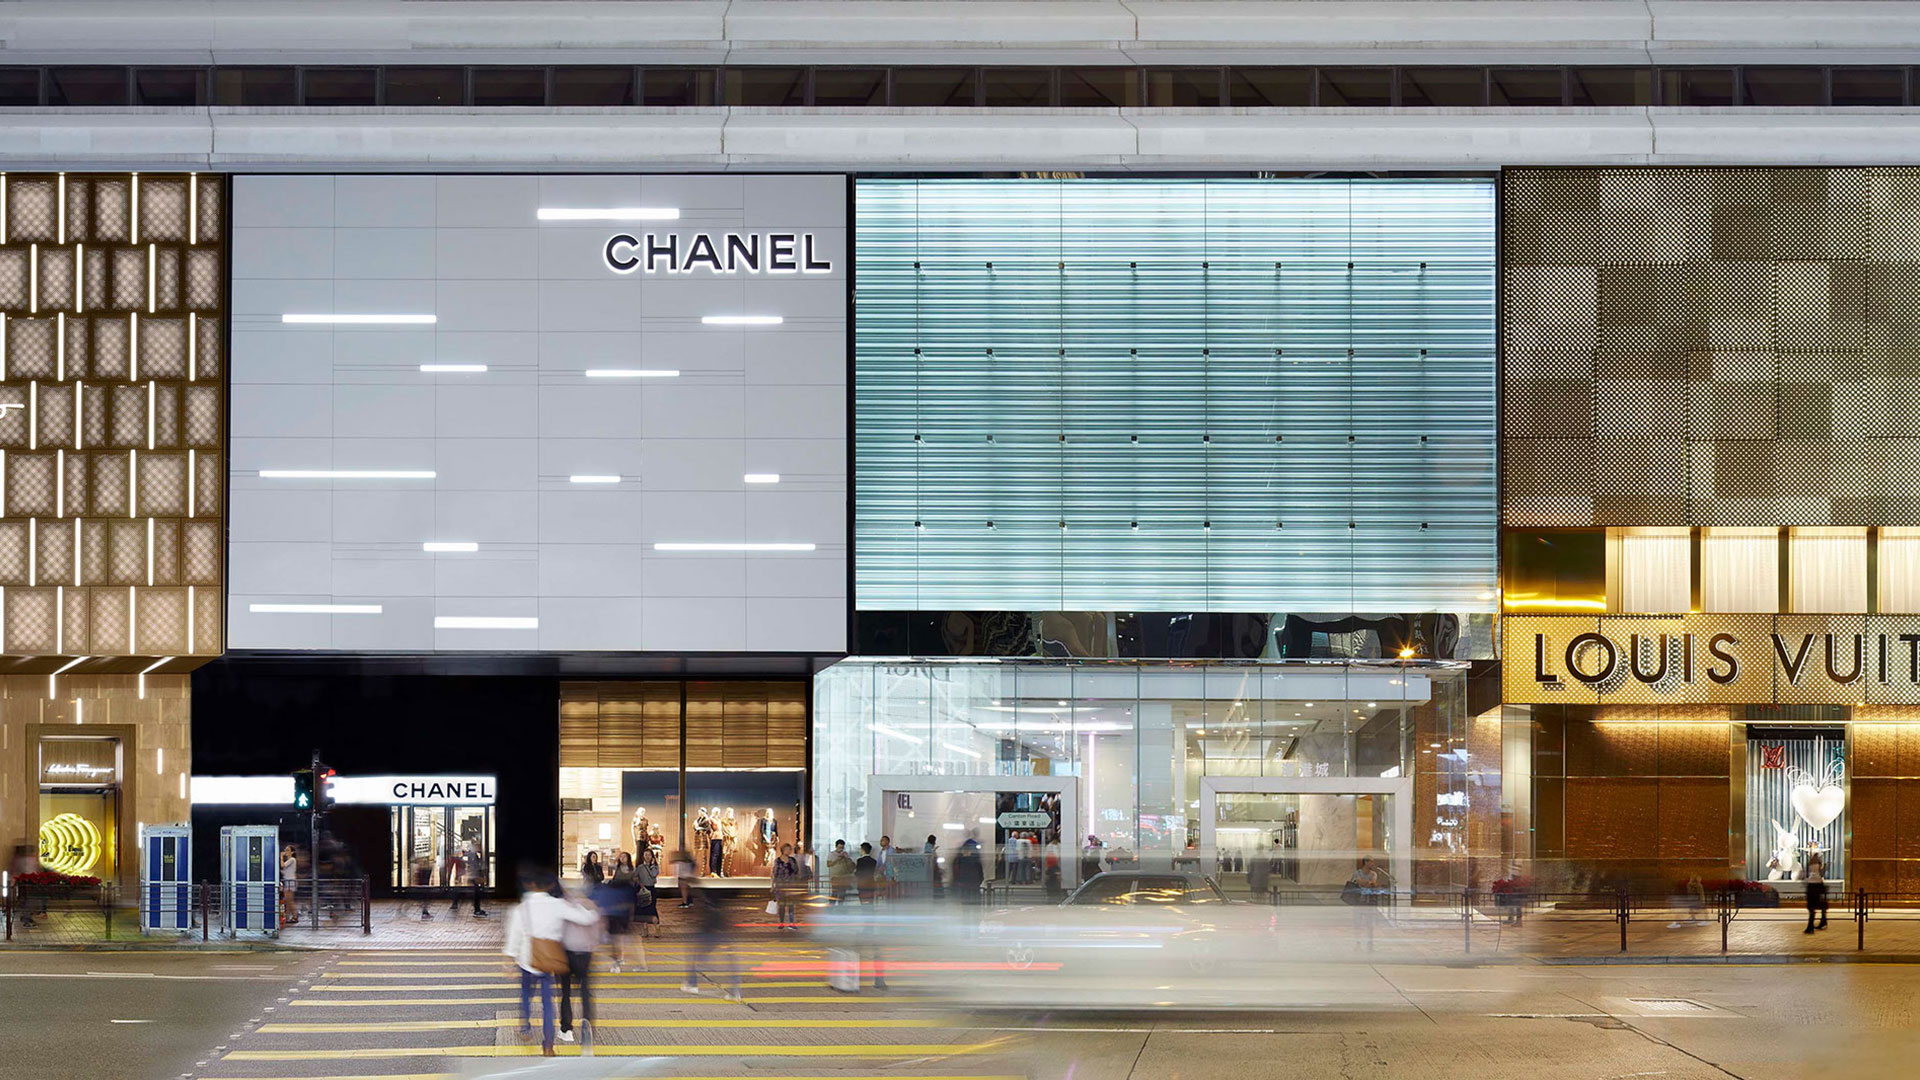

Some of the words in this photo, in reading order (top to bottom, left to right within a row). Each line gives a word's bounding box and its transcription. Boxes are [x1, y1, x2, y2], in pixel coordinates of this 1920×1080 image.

[605, 233, 831, 271] CHANEL
[1535, 632, 1740, 685] LOUIS
[393, 782, 493, 799] CHANEL
